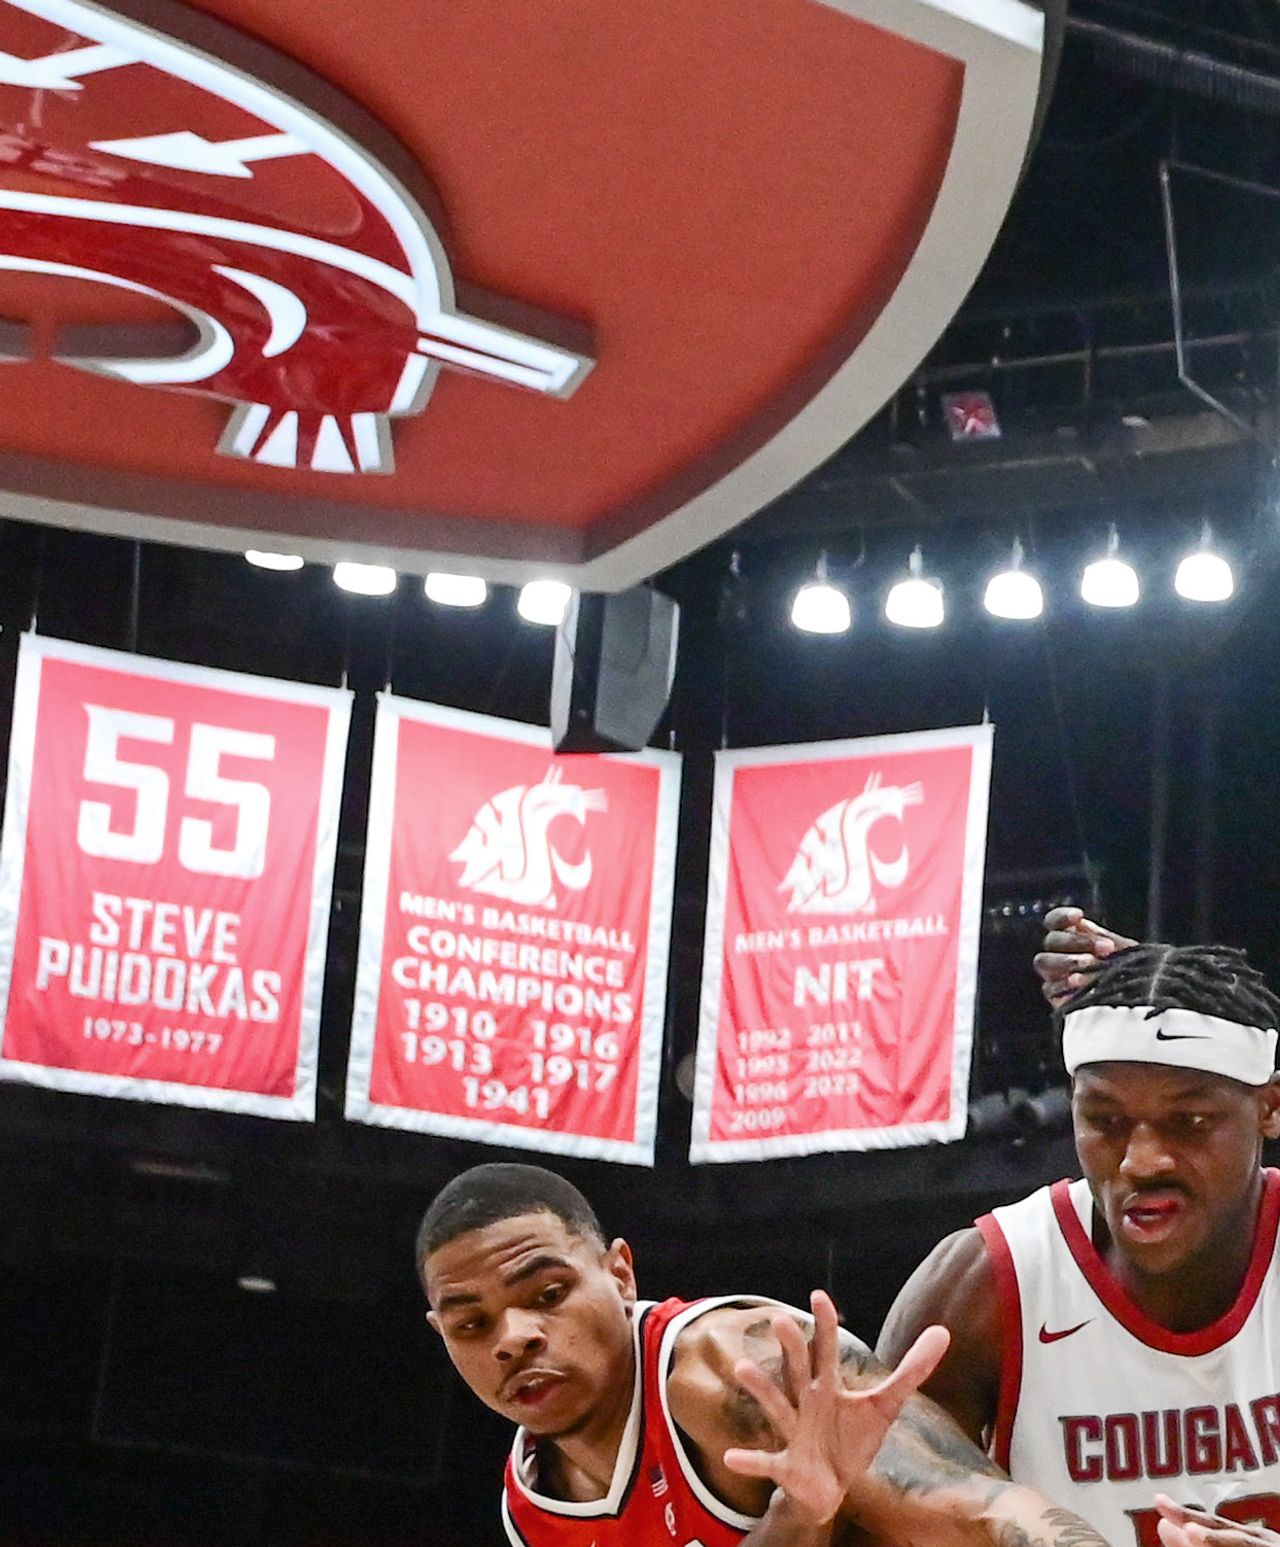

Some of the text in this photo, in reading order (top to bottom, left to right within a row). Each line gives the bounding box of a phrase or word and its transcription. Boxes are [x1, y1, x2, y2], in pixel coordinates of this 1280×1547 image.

[77, 703, 275, 880] 55
[90, 893, 241, 963] STEVE
[400, 892, 636, 953] MEN'S BASKETBALL
[736, 914, 948, 954] MEN'S BASKETBALL
[36, 937, 282, 1024] PUIDOKAS
[407, 925, 624, 987] CONFERENCE
[793, 958, 884, 1008] NIT
[392, 956, 634, 1024] CHAMPIONS
[83, 1016, 224, 1054] 1973-1977
[403, 998, 619, 1061] 1910 1916
[806, 1021, 862, 1047] 2011
[402, 1031, 617, 1091] 1913 1917
[462, 1076, 551, 1119] 1941
[729, 1108, 786, 1132] 2009
